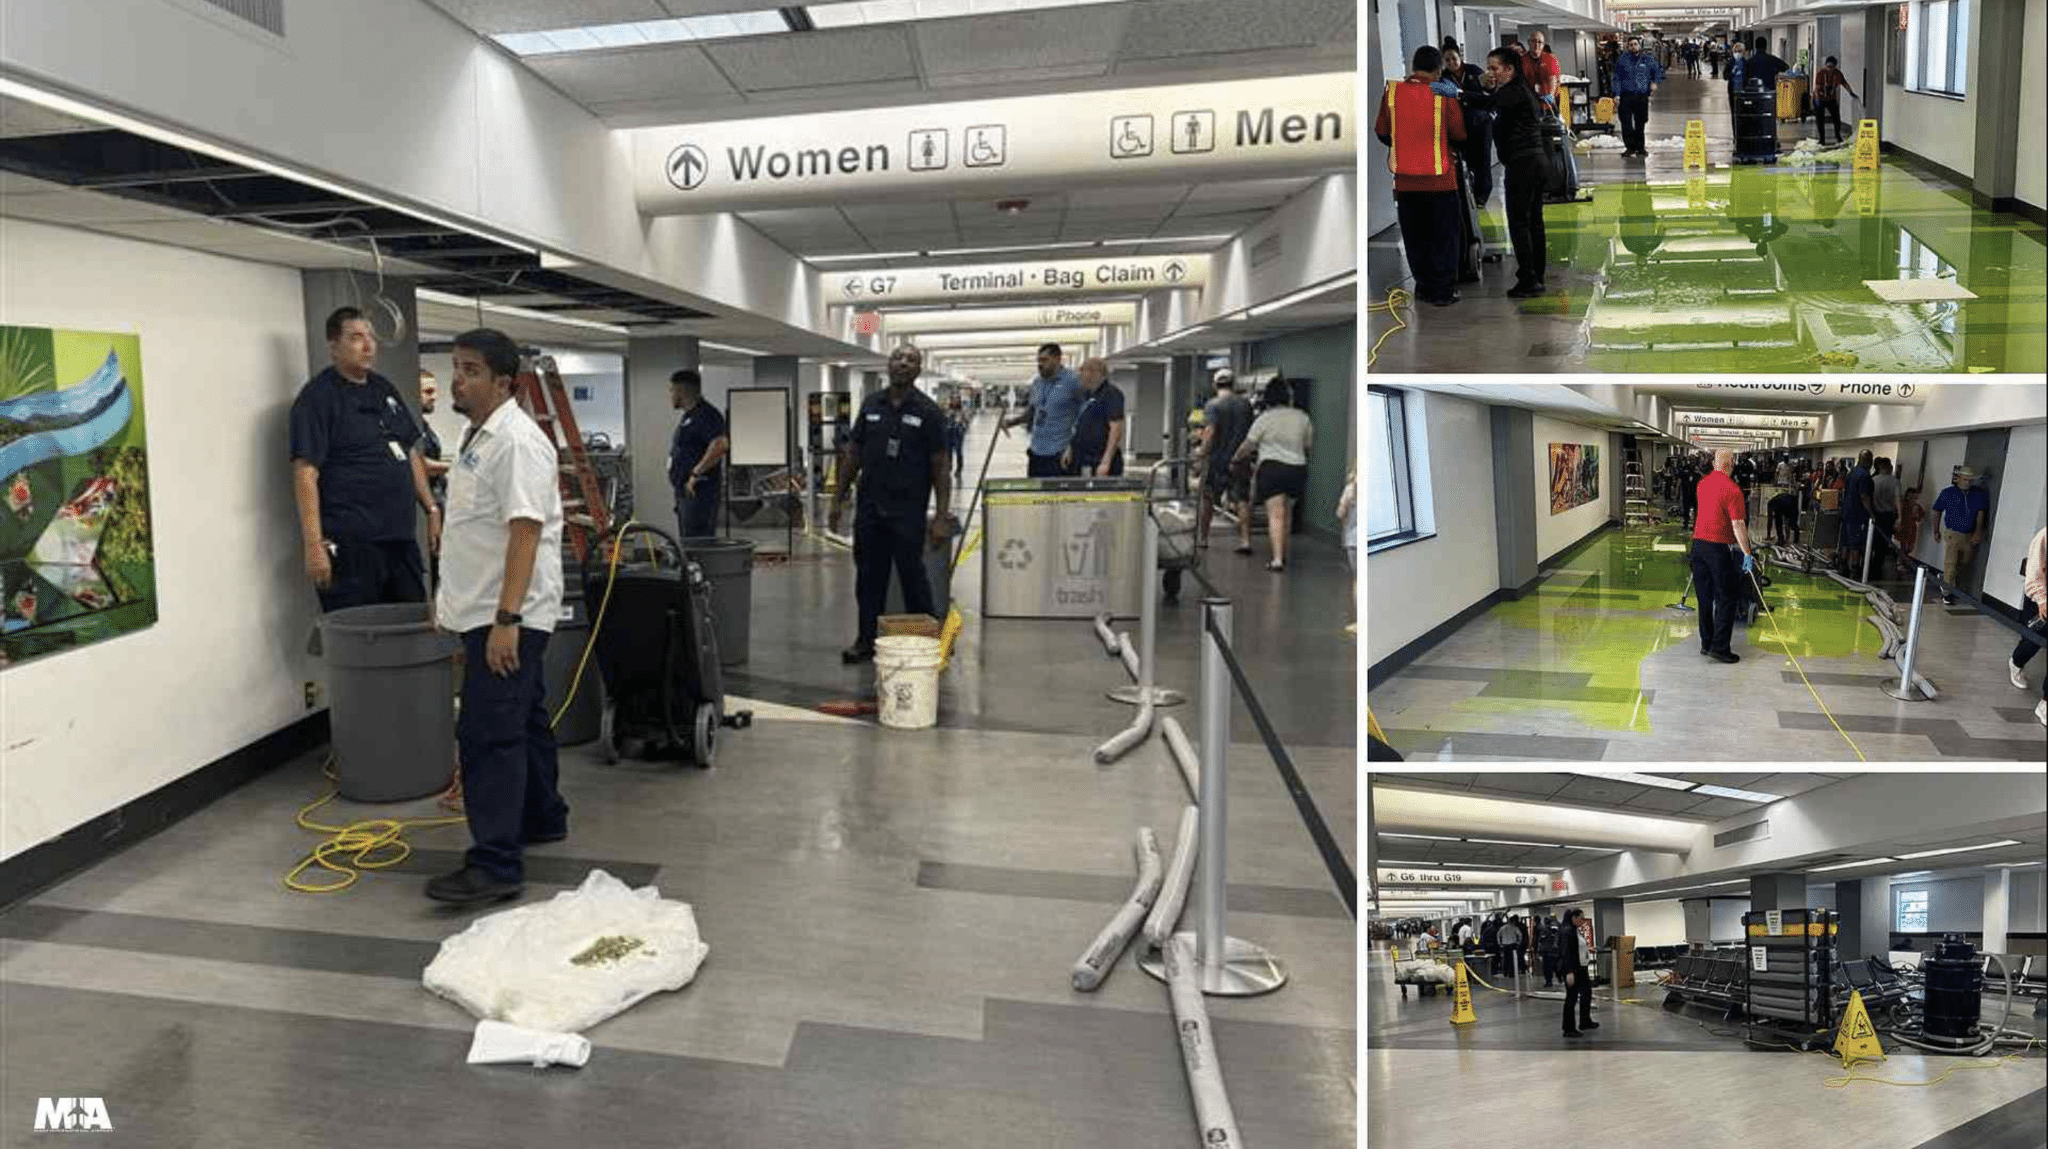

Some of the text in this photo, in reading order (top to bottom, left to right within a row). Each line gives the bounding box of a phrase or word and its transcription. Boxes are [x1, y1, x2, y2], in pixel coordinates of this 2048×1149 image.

[1236, 107, 1342, 147] Men
[727, 141, 890, 180] Women
[870, 276, 897, 294] G7
[940, 263, 1155, 291] Terminal Bag Claim
[1694, 415, 1725, 423] Women
[1400, 873, 1462, 882] G6 thru G19
[1515, 876, 1528, 884] G7
